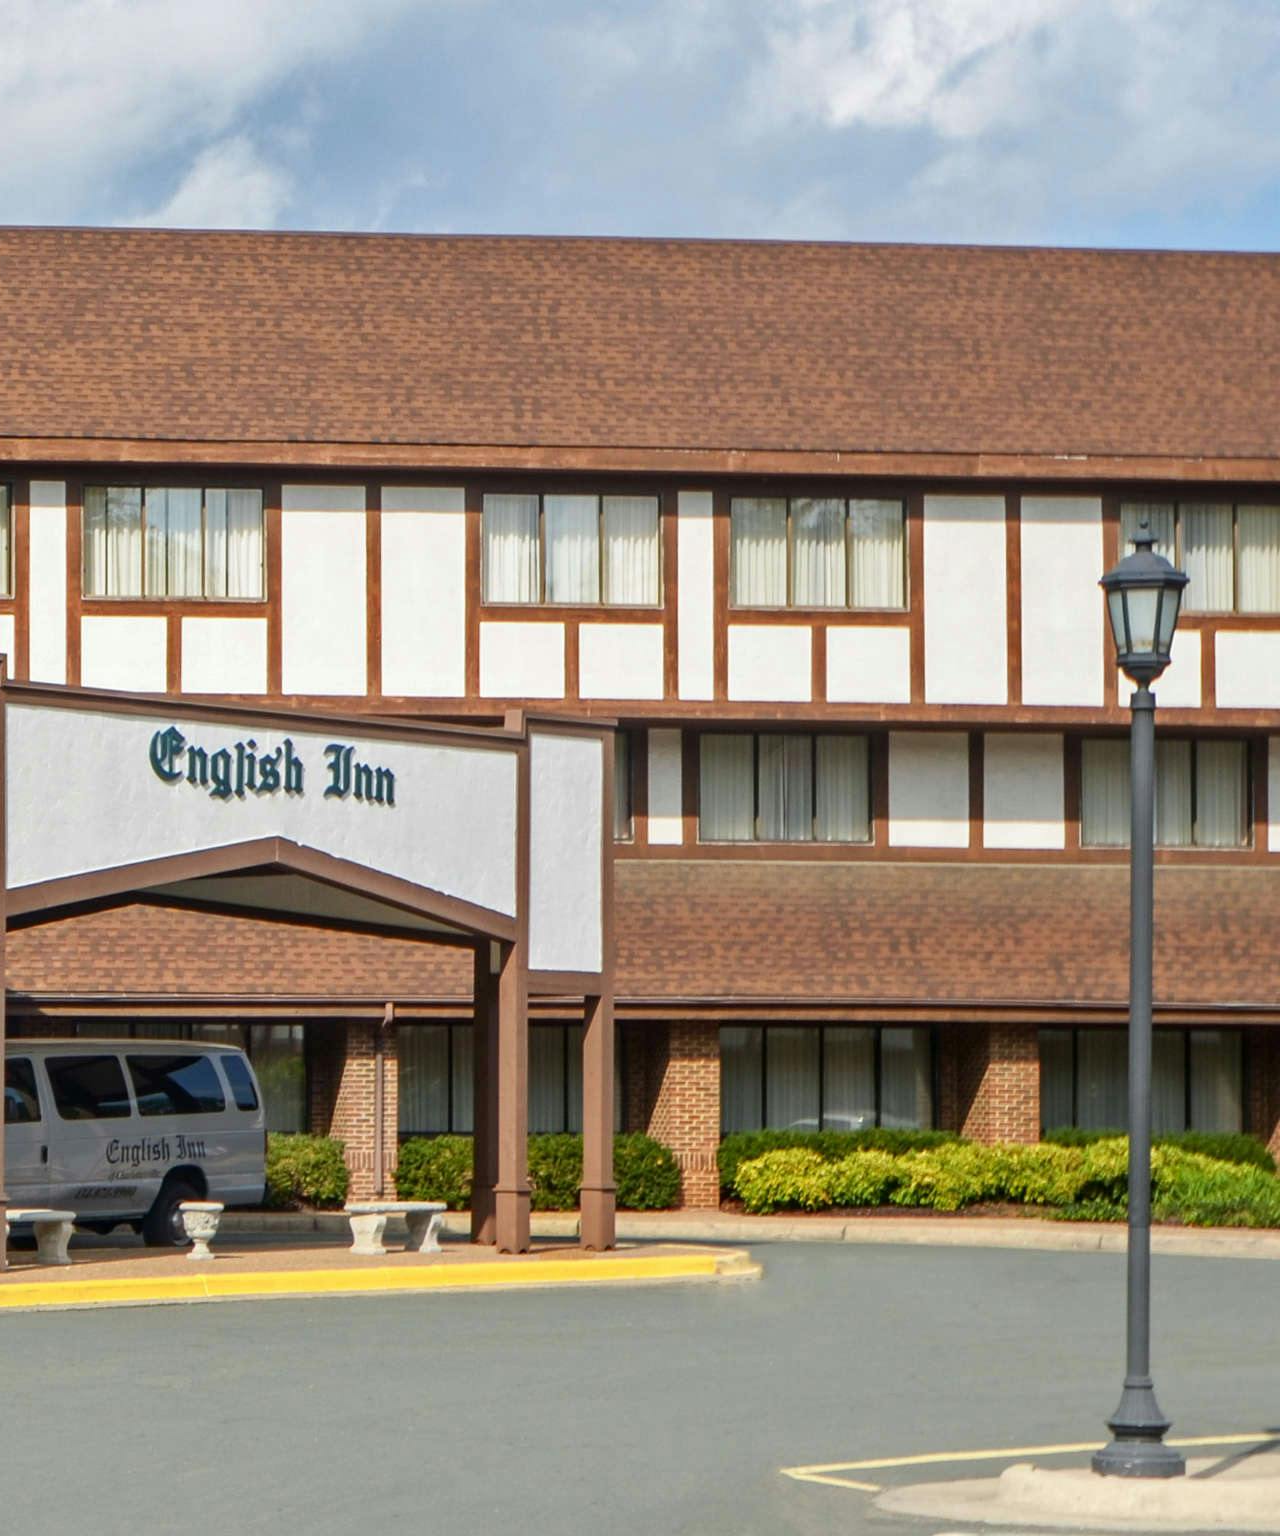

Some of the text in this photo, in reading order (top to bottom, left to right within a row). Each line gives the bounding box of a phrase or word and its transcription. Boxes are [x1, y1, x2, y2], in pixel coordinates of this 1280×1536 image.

[149, 726, 396, 806] English Inn
[106, 1134, 206, 1167] English Inn
